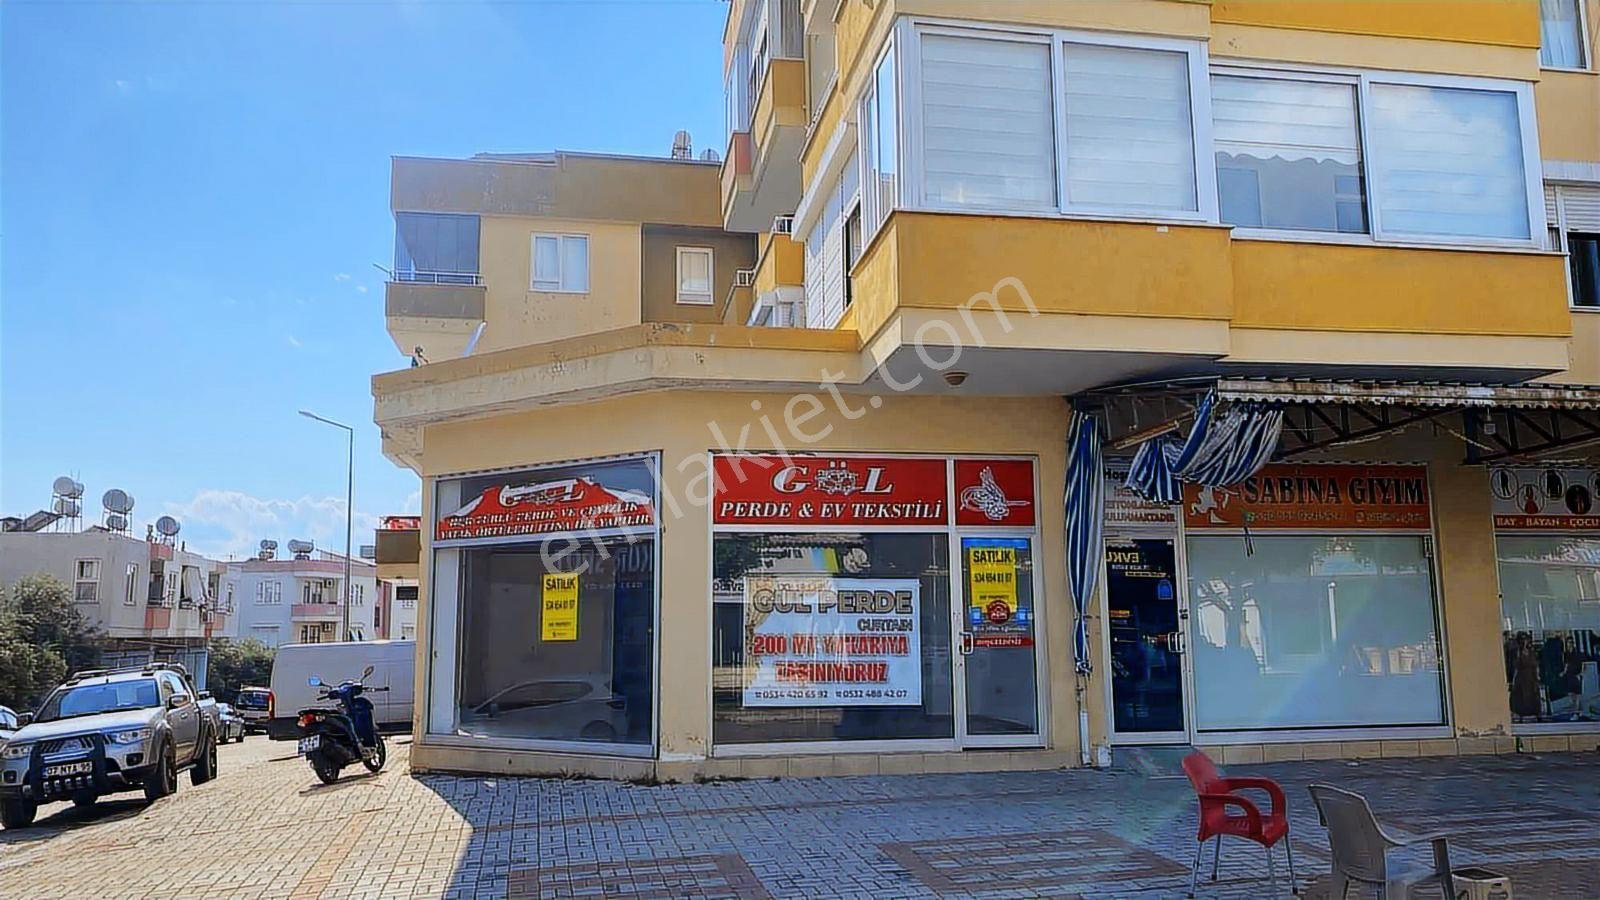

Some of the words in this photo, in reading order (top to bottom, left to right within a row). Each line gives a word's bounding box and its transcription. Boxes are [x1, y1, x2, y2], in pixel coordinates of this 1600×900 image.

[719, 502, 791, 518] PERDE
[798, 502, 813, 518] &
[820, 502, 846, 518] EV
[851, 499, 942, 518] TEKSTİLİ
[1525, 517, 1560, 527] BAYAN
[973, 550, 1011, 563] SATILIK
[545, 578, 576, 591] SATILIK
[818, 589, 914, 614] PERDE
[753, 634, 788, 656] 200
